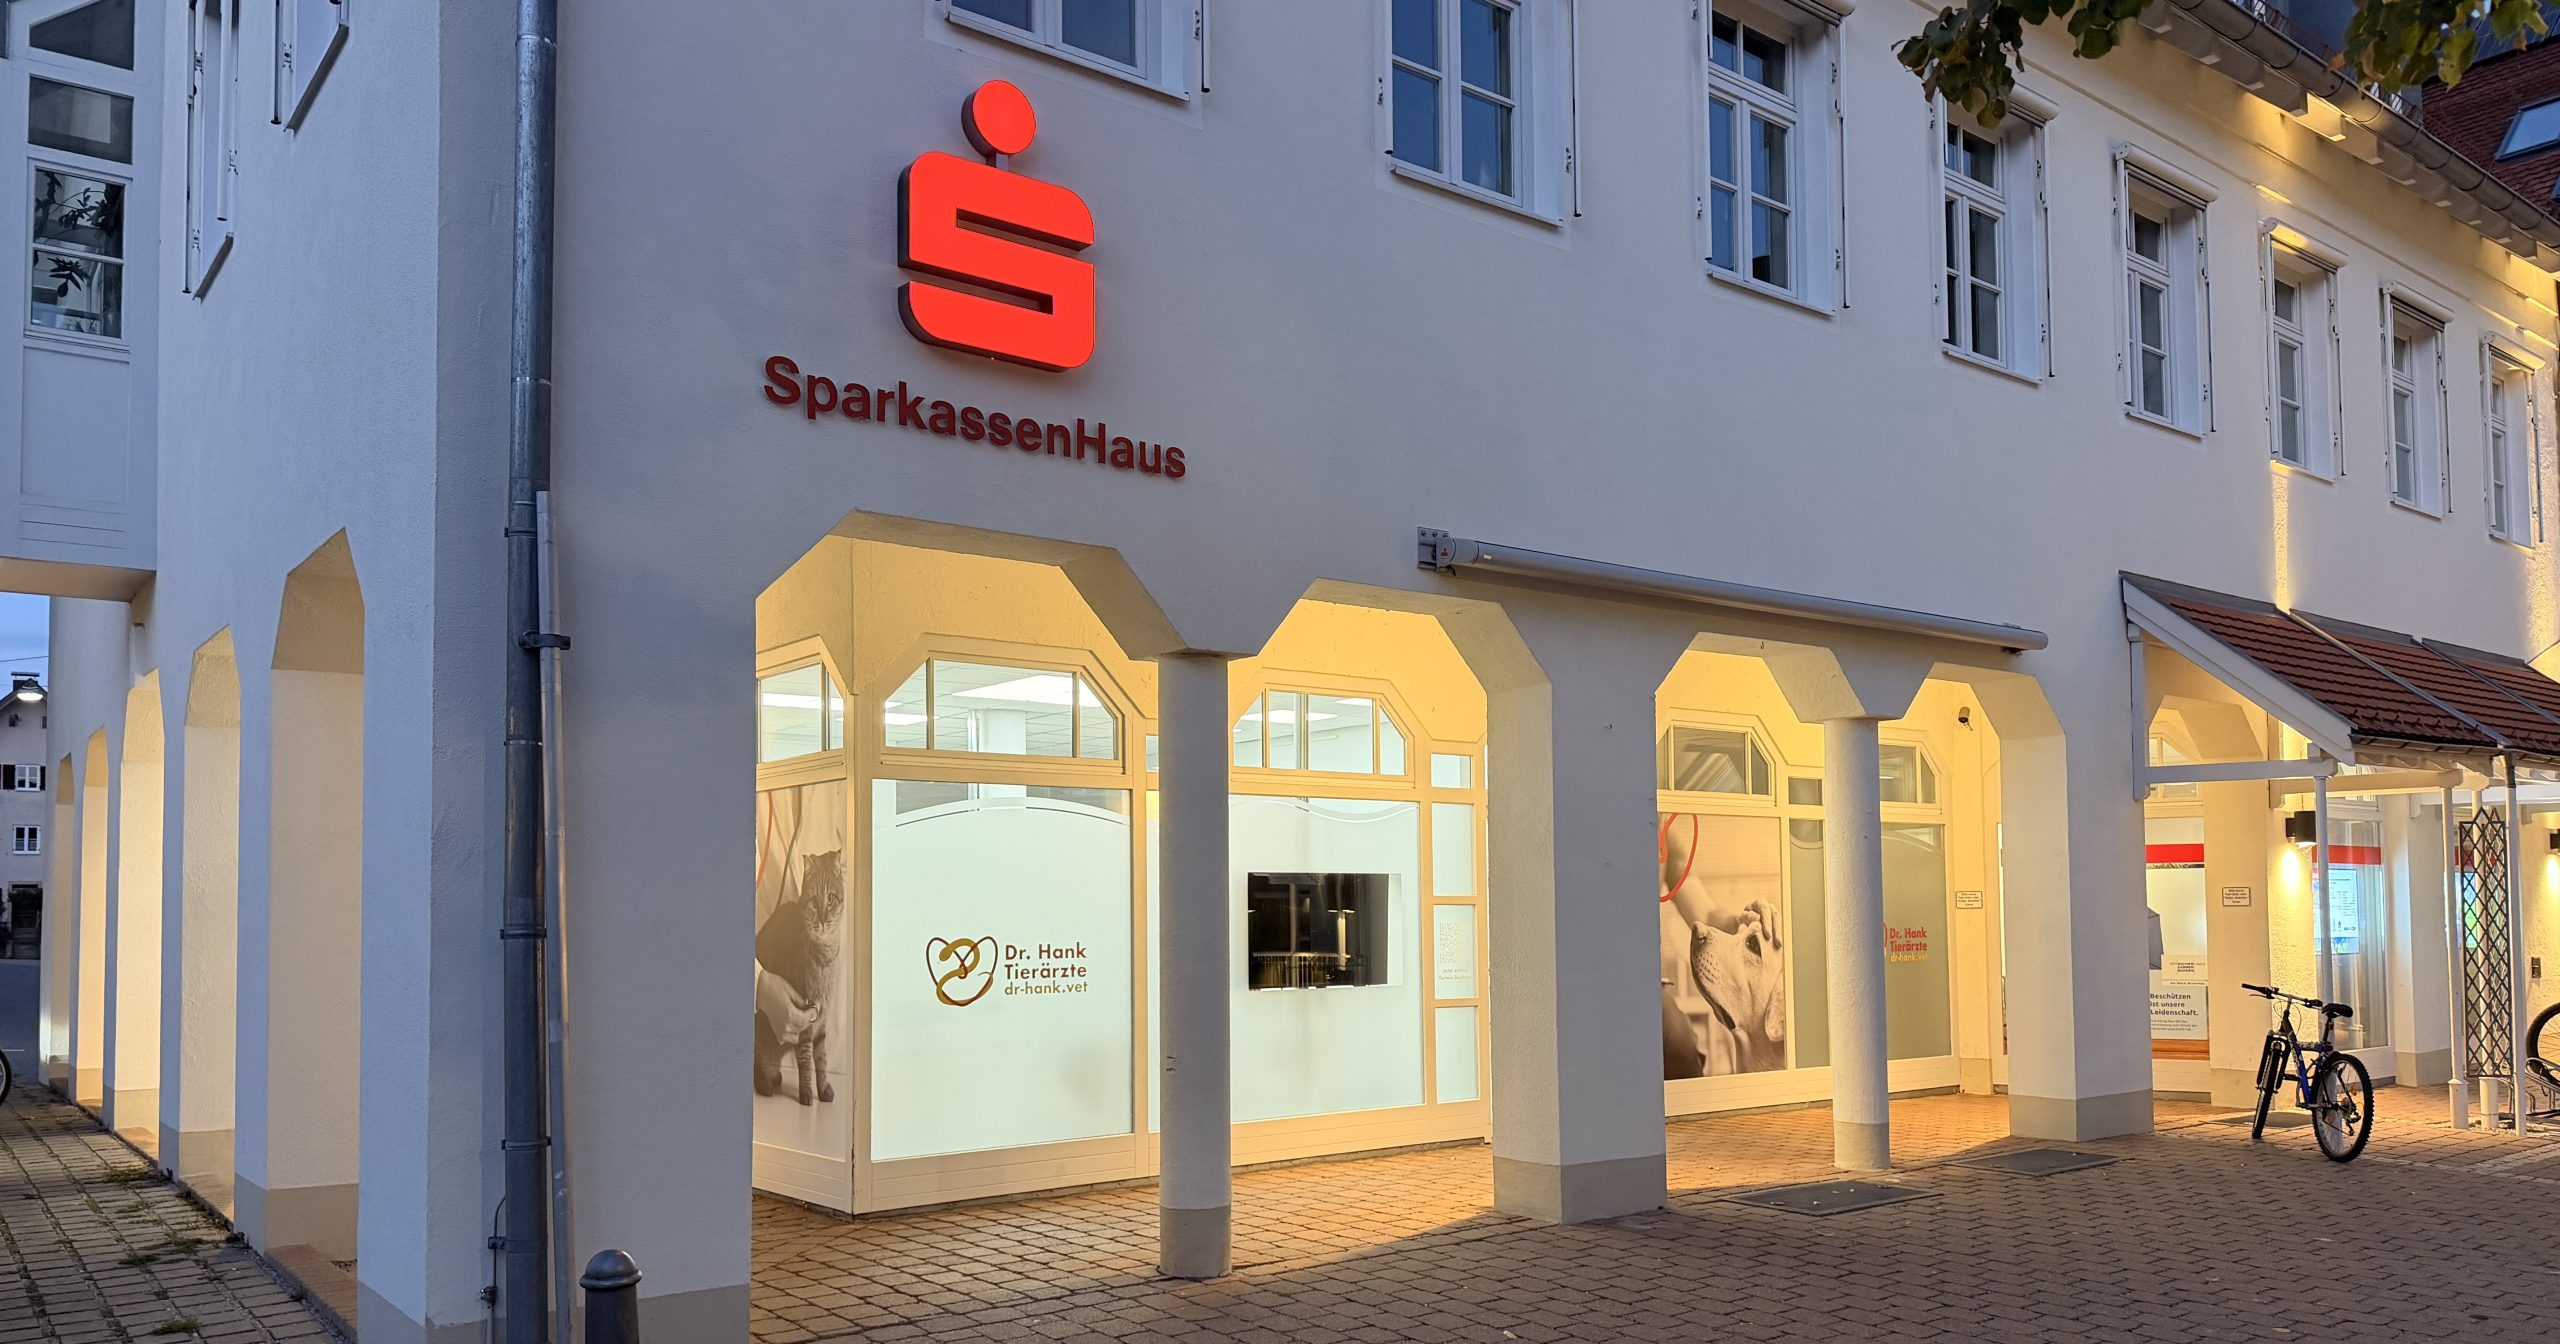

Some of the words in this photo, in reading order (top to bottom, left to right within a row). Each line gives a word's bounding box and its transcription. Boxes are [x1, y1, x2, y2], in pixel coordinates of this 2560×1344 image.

[763, 355, 1187, 479] SparkassenHaus
[1890, 927, 1902, 939] Dr.
[1903, 926, 1927, 939] Hank
[1005, 944, 1031, 960] Dr.
[1038, 942, 1087, 960] Hank
[1890, 940, 1927, 952] Tierärzte
[1004, 963, 1087, 980] Tierärzte
[1004, 981, 1088, 996] dr-hank.vet
